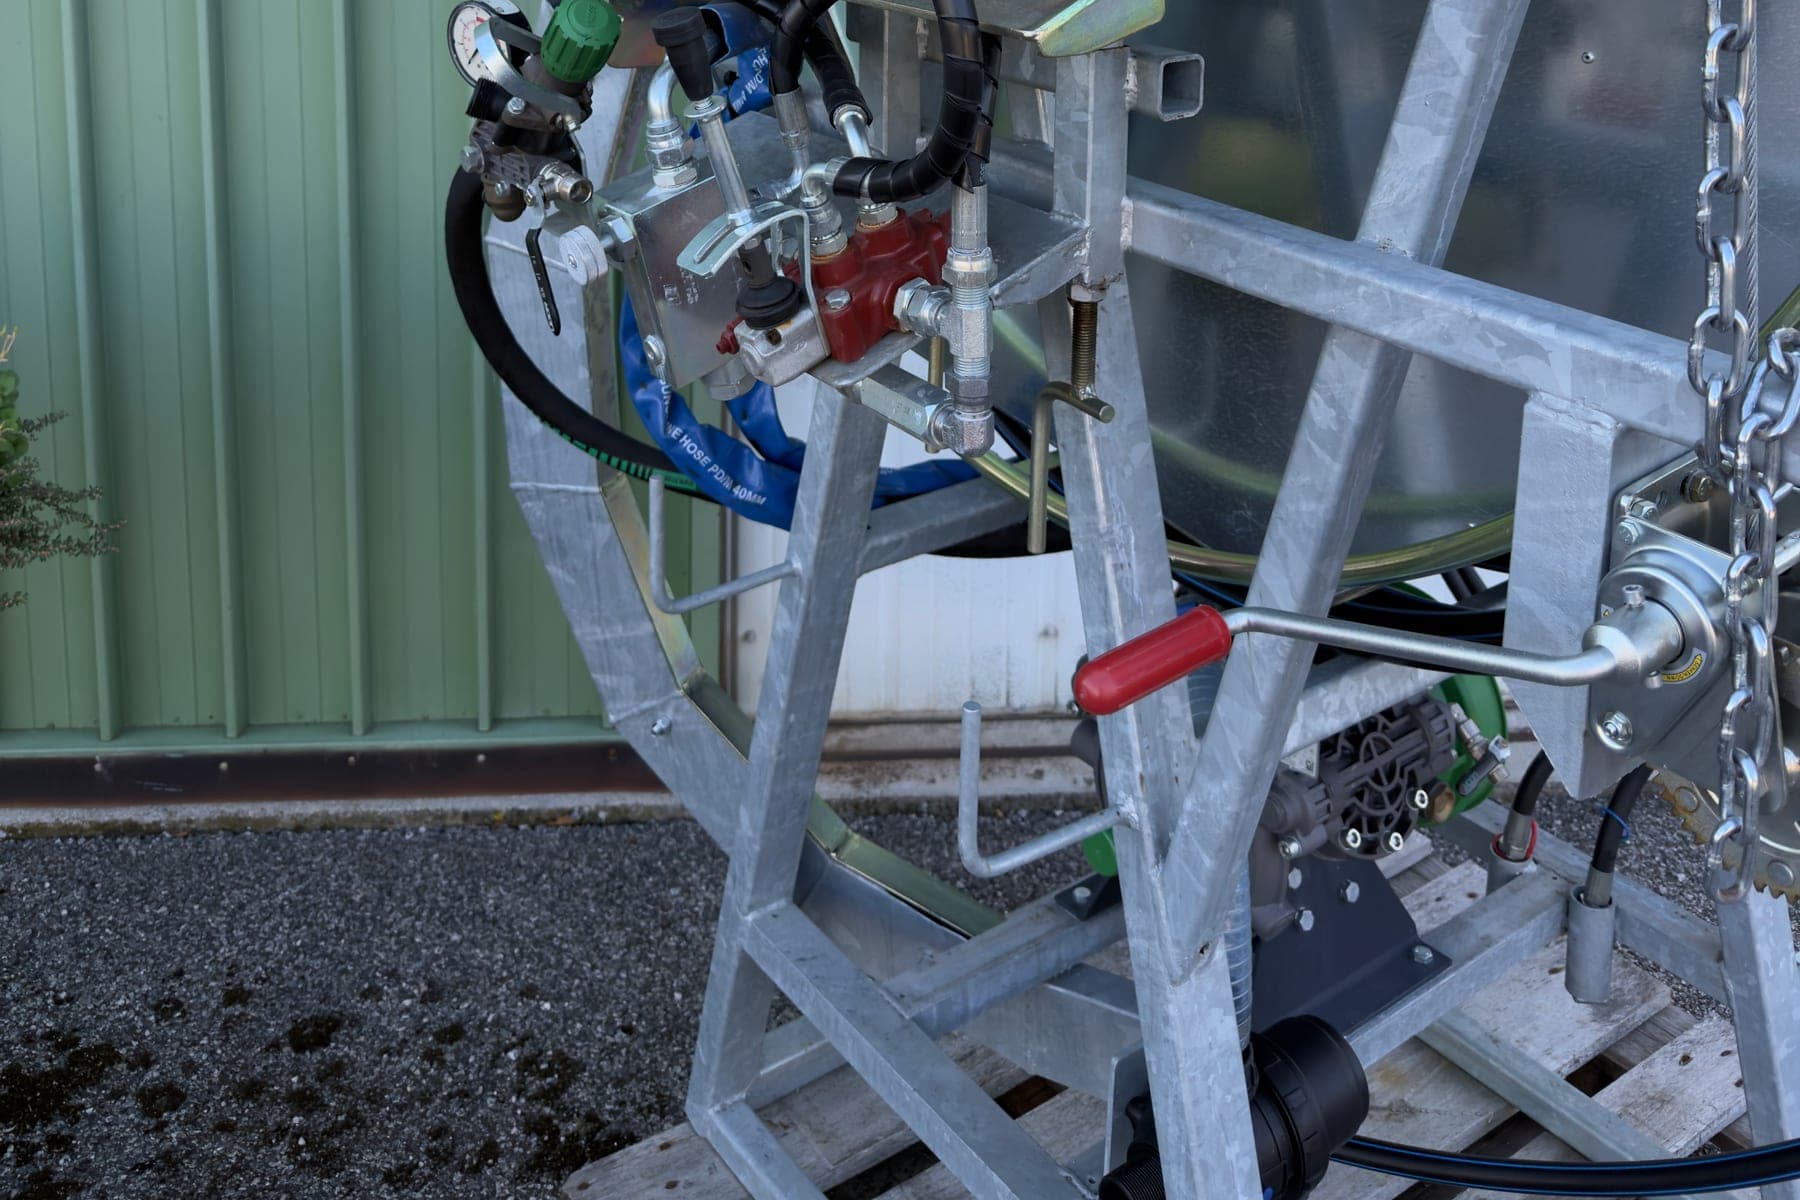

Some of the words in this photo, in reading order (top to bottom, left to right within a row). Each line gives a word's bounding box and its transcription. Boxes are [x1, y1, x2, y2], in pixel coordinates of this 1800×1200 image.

[679, 434, 711, 468] HOSE
[707, 463, 734, 491] PD/M
[732, 485, 767, 505] 40MM
